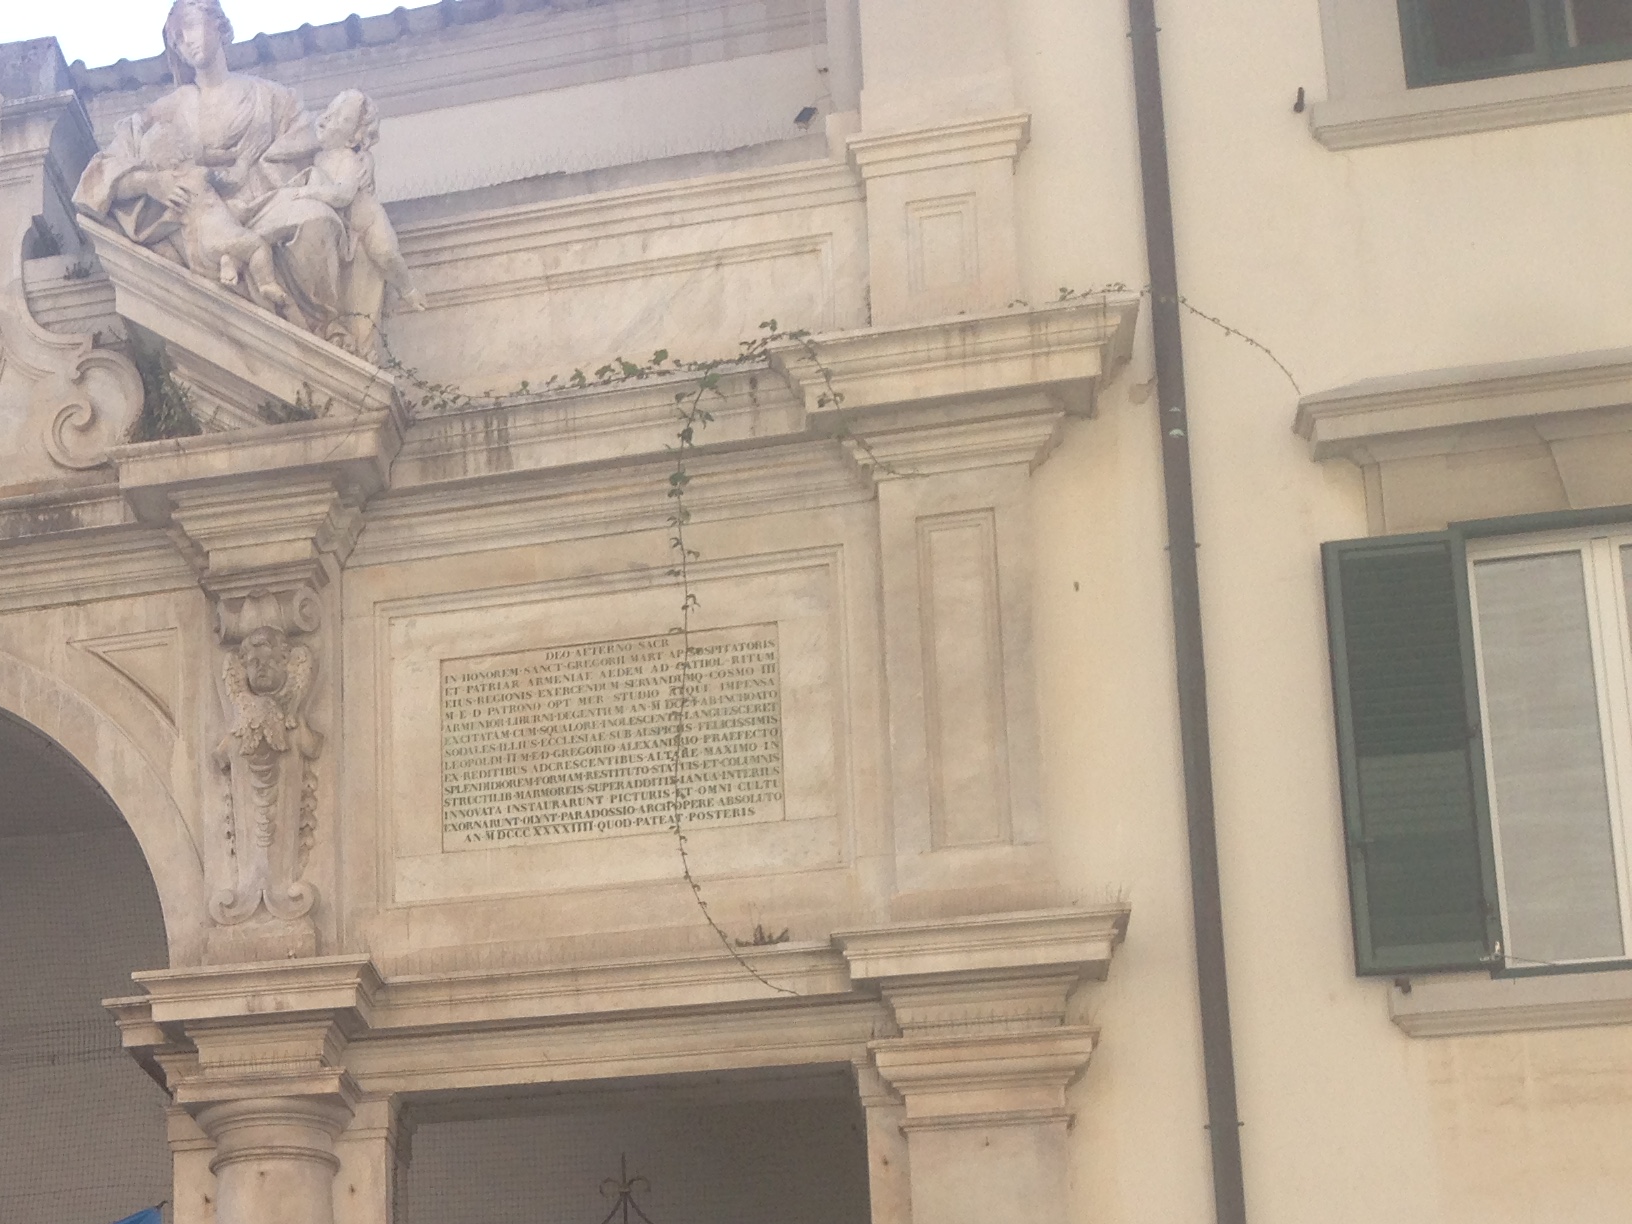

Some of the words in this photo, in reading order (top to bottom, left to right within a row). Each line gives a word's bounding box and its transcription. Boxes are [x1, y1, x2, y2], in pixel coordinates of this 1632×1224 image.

[444, 674, 456, 684] IN
[445, 686, 460, 696] ET
[688, 806, 756, 821] POSTERIS
